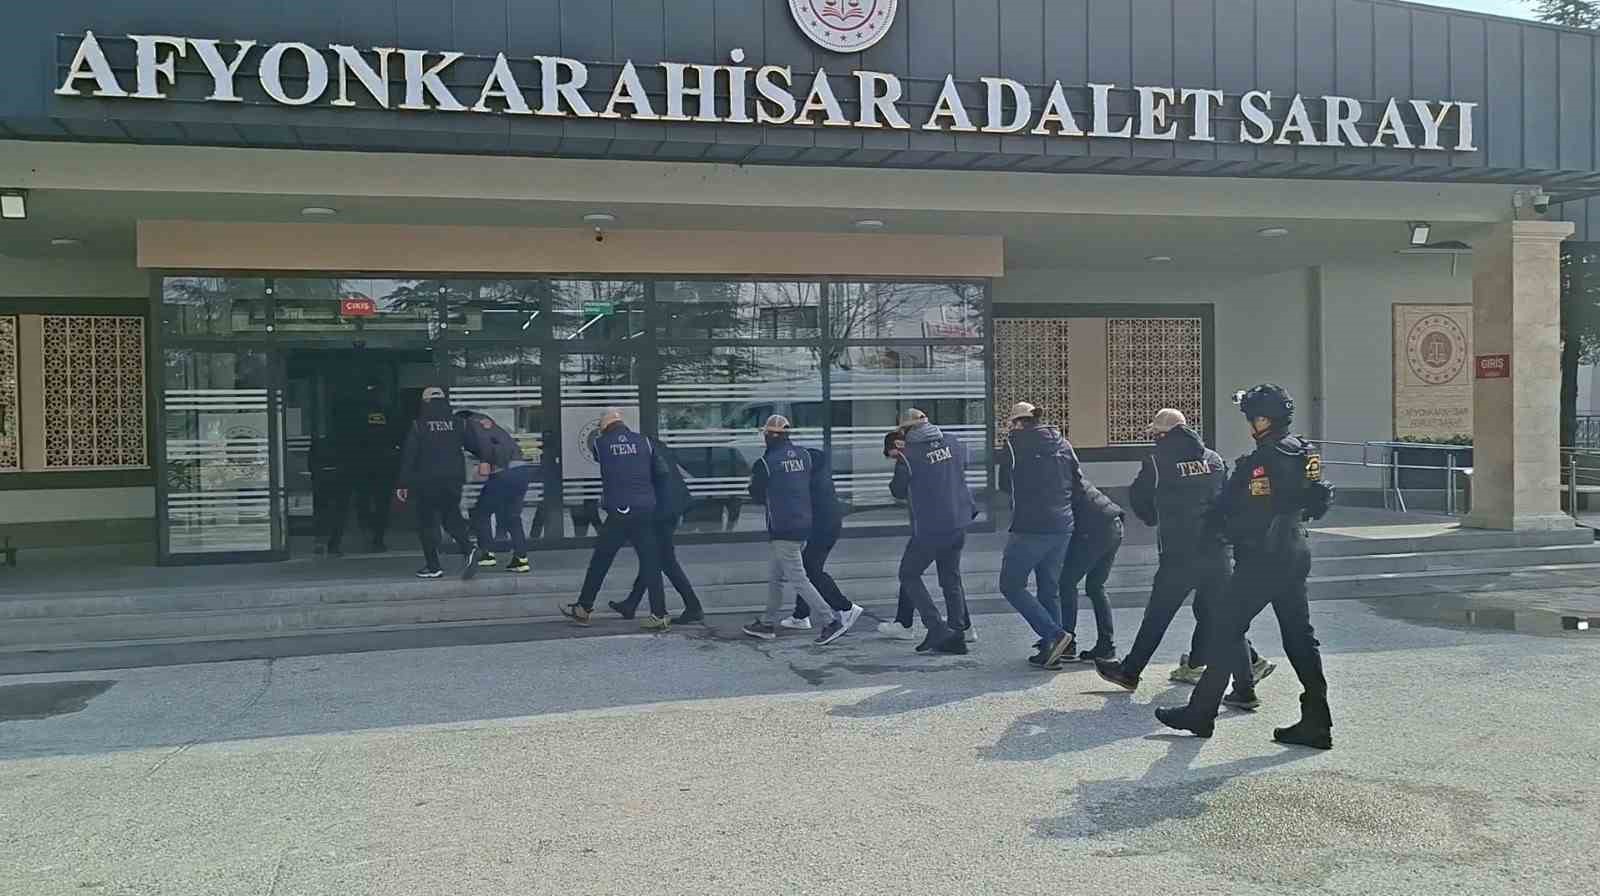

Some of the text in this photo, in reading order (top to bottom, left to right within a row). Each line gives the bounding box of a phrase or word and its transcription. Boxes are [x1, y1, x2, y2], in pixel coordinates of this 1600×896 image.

[54, 30, 1478, 151] AFYONKARAHİSAR ADALET SARAYI
[427, 420, 454, 432] TEM
[610, 443, 637, 456] TEM
[926, 447, 952, 464] TEM
[782, 459, 805, 472] TEM
[1176, 461, 1211, 477] TEM
